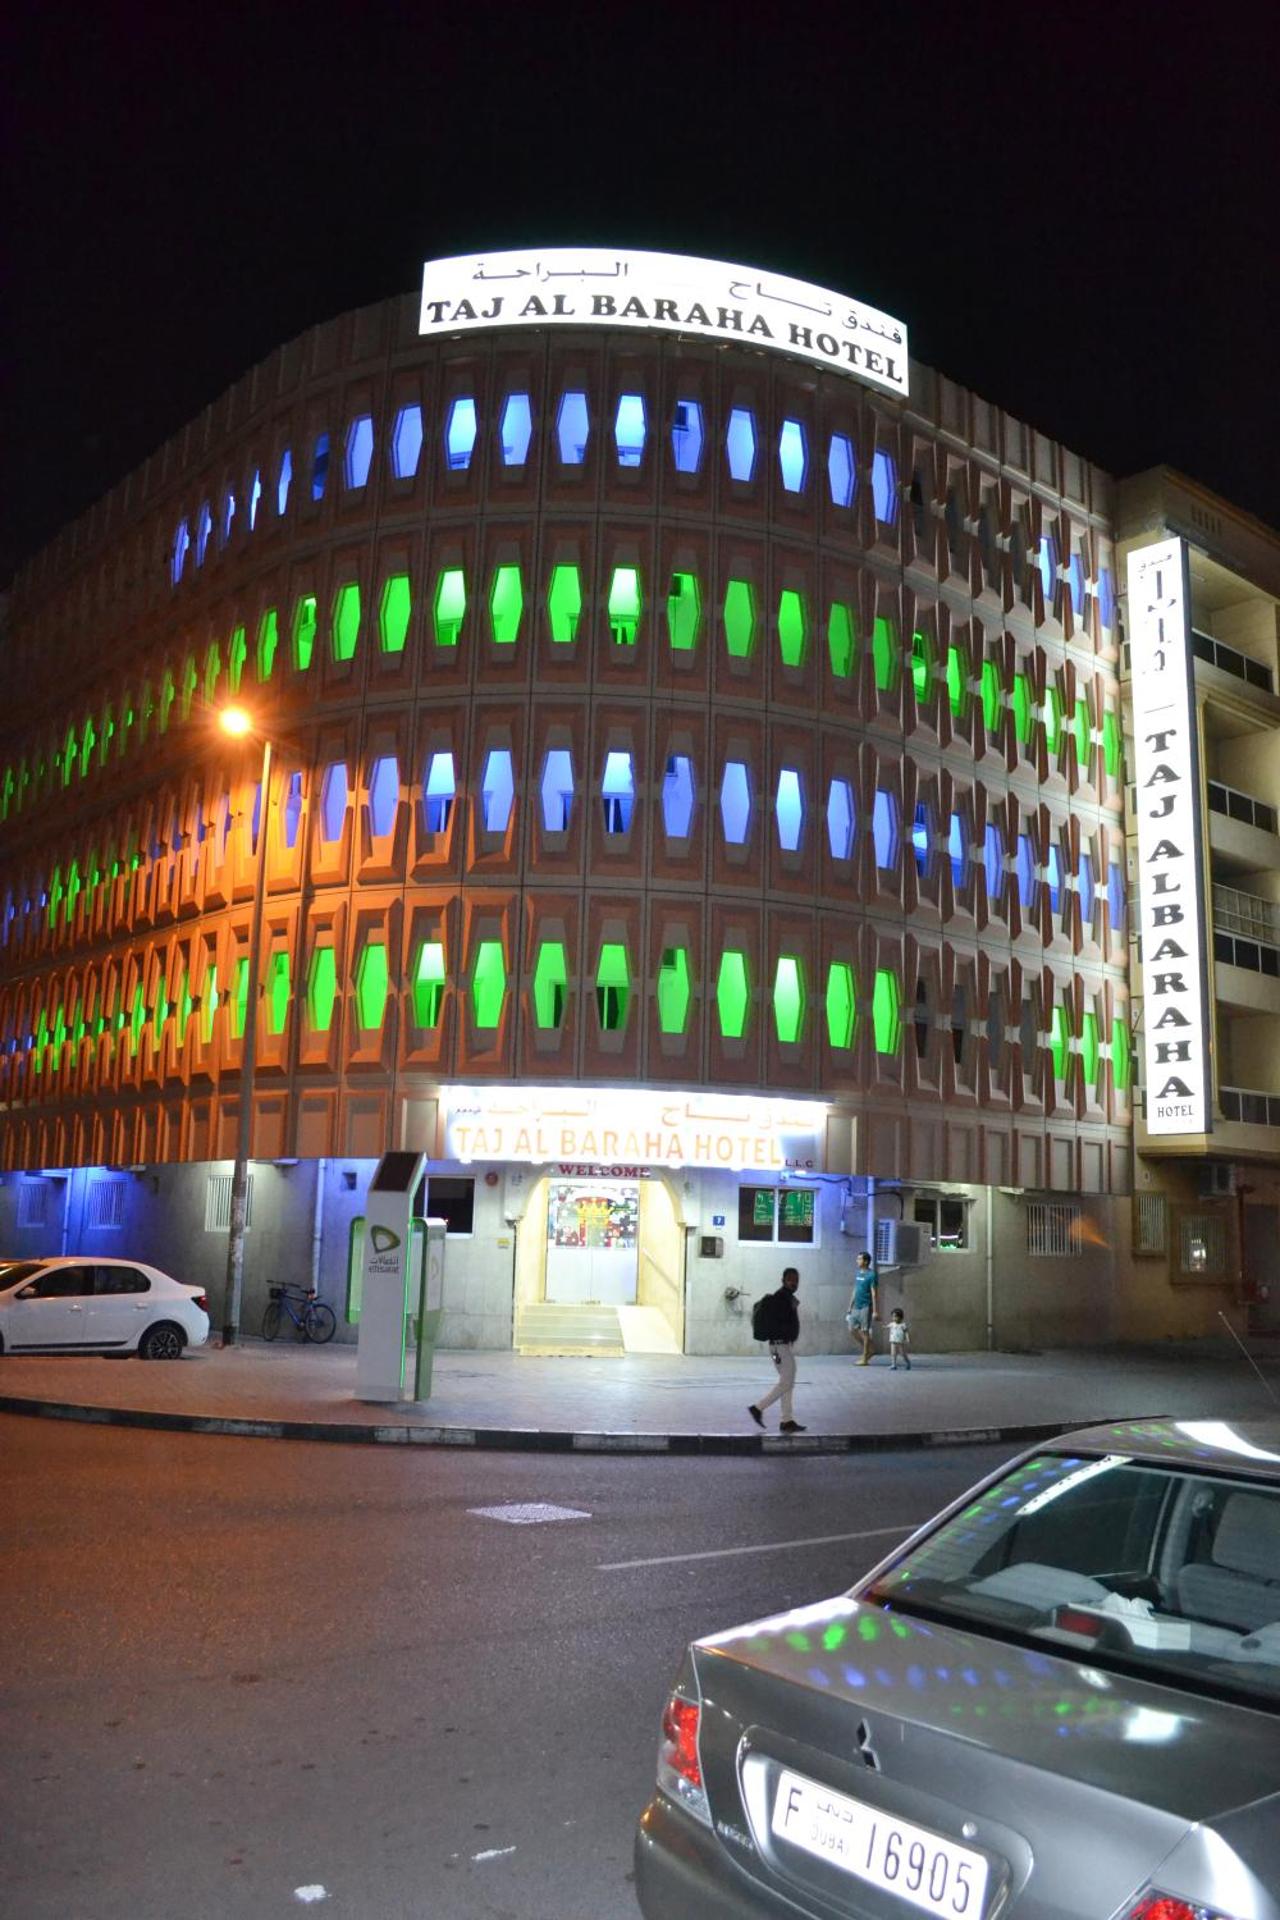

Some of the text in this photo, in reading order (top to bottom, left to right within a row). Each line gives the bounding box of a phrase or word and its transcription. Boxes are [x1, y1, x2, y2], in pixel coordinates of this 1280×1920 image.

[472, 261, 629, 283] البراحة
[728, 281, 833, 316] تاج
[427, 294, 904, 384] TAJ AL BARAHA HOTEL
[1143, 729, 1181, 819] TAJ
[1157, 1104, 1194, 1118] HOTEL
[456, 1127, 503, 1154] TAJ
[515, 1128, 549, 1155] AL
[560, 1129, 684, 1160] BARAHA
[694, 1133, 782, 1165] HOTEL
[558, 1163, 652, 1179] WELCOME
[784, 1787, 972, 1914] F 16905
